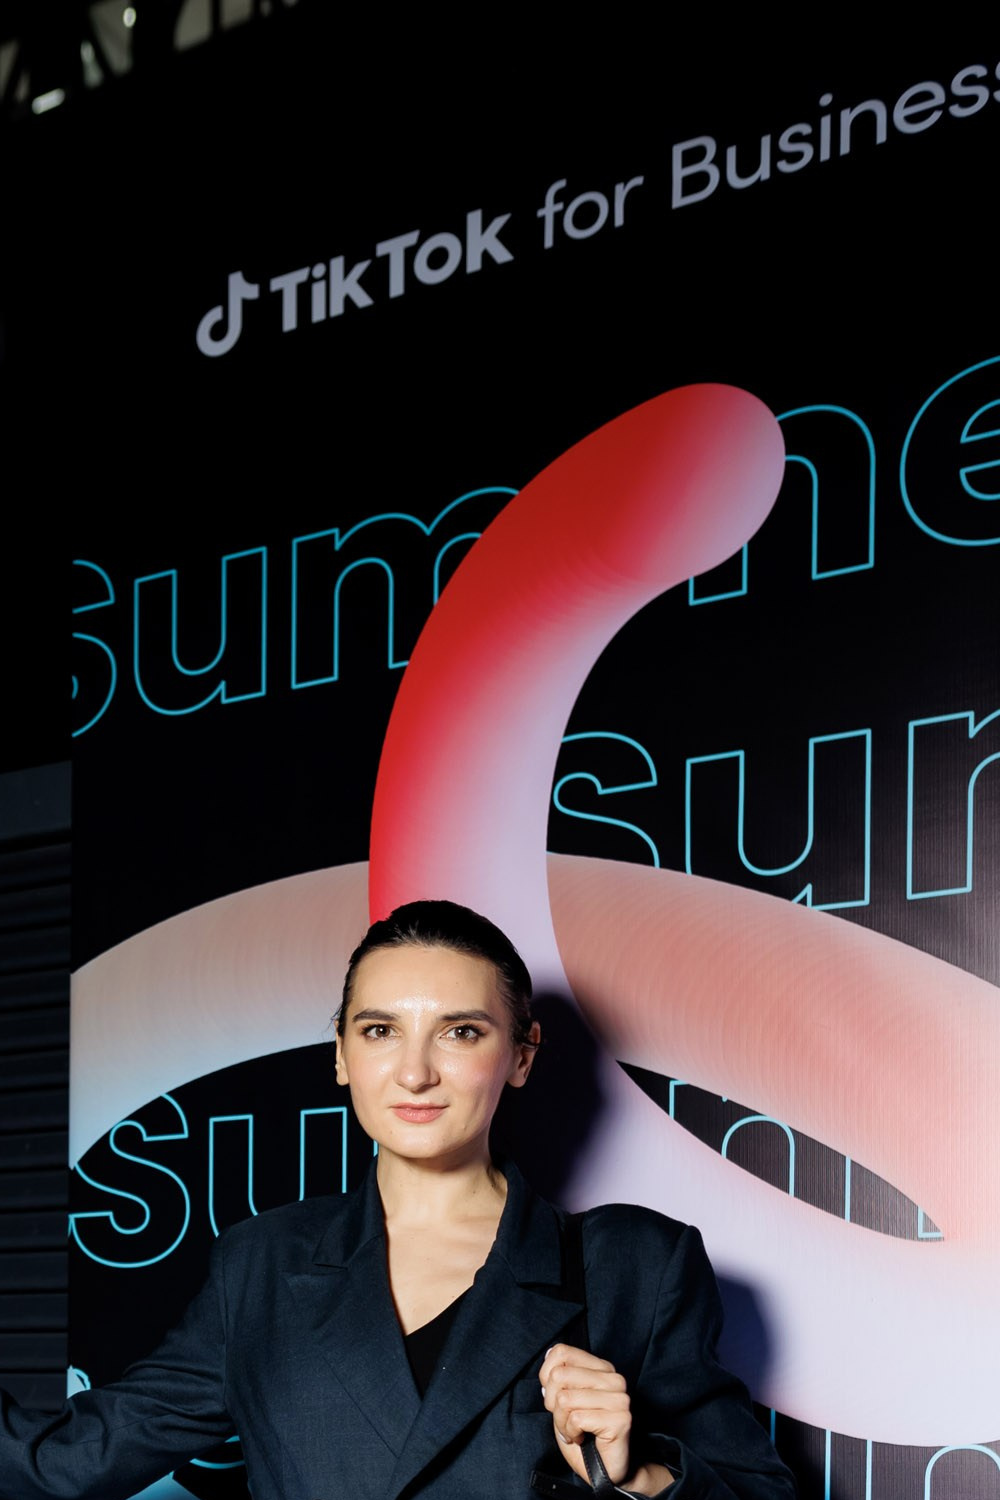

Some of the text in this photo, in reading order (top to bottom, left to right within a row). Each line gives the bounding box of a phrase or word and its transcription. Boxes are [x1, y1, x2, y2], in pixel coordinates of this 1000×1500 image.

[270, 61, 1000, 331] TikTok for Busines
